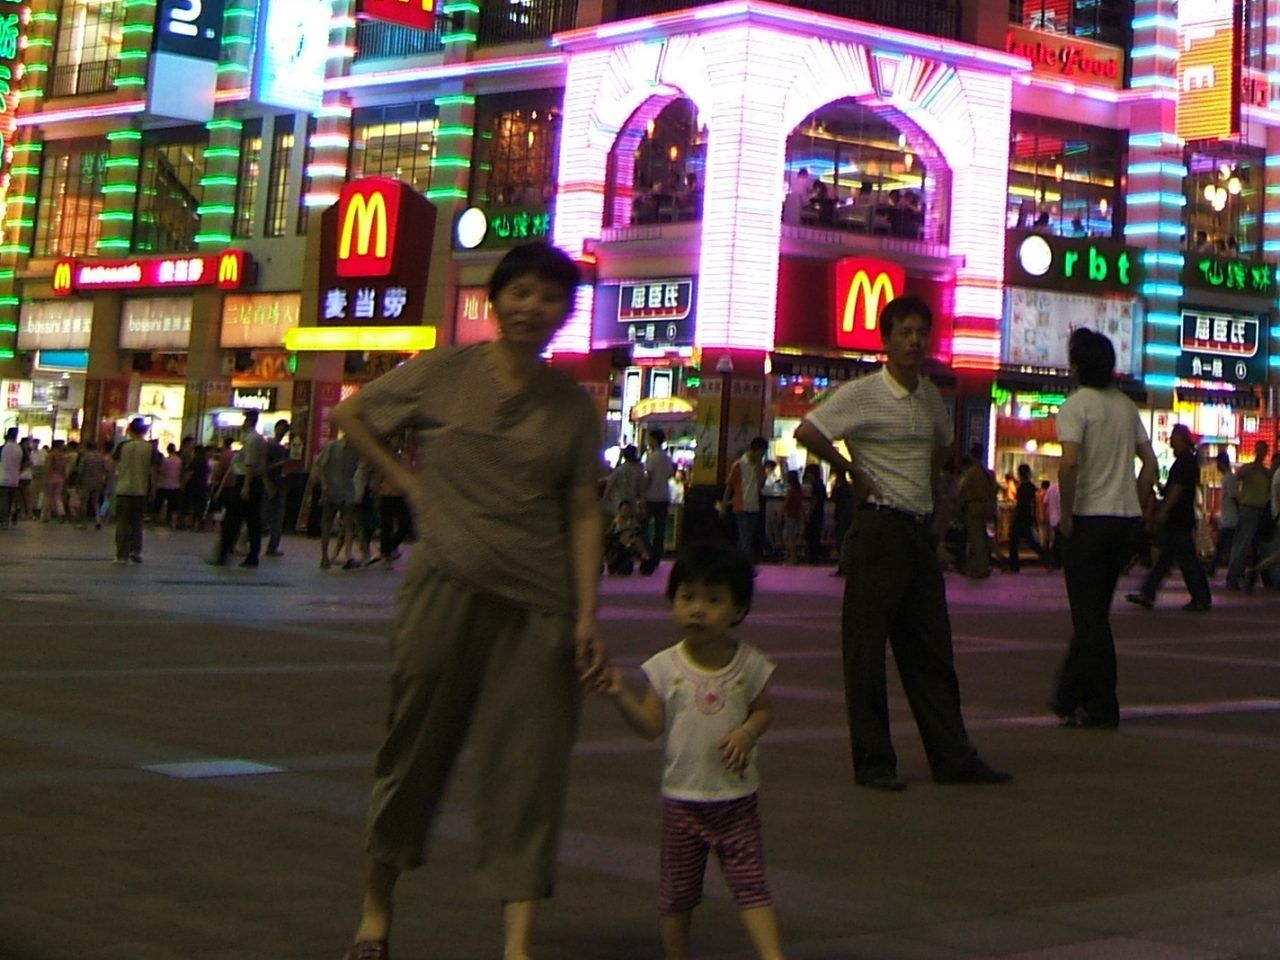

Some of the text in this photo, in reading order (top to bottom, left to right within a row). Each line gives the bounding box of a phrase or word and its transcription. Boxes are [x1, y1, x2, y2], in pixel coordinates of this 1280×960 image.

[325, 286, 408, 320] 麦当劳
[631, 283, 679, 309] 屈臣氏
[1194, 316, 1246, 344] 屈臣氏
